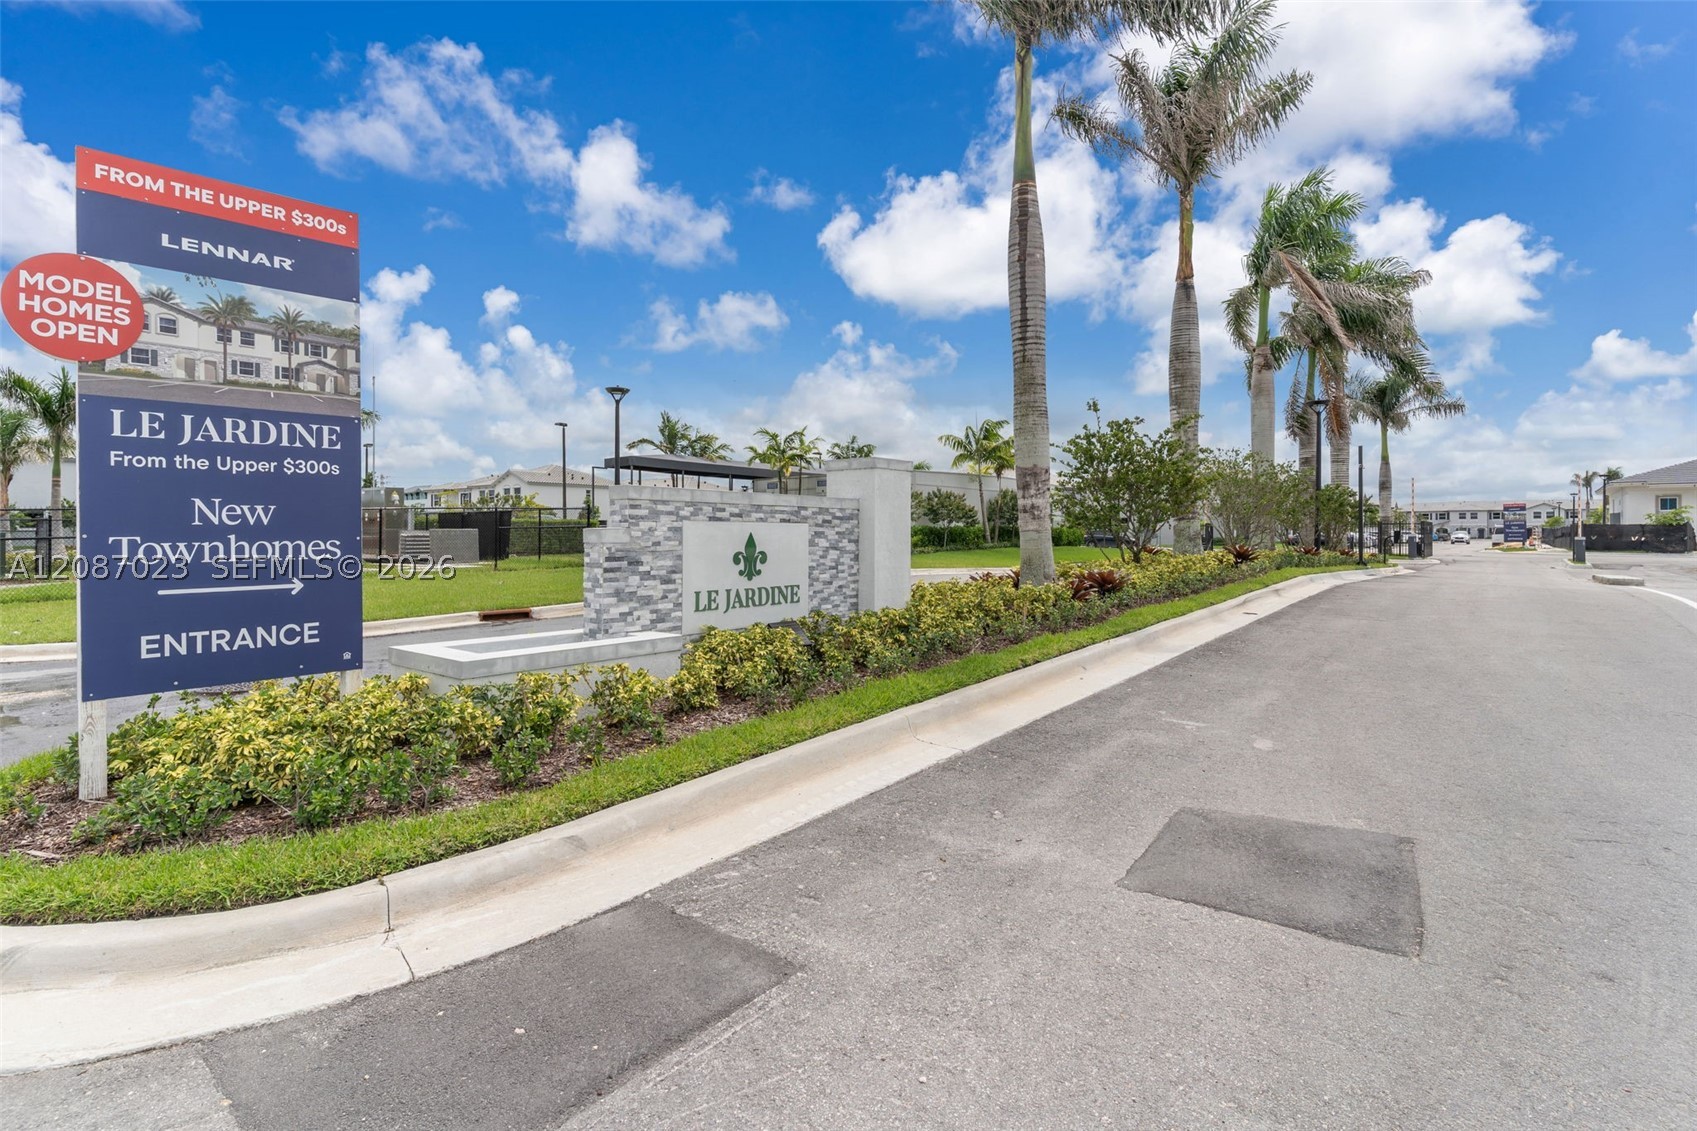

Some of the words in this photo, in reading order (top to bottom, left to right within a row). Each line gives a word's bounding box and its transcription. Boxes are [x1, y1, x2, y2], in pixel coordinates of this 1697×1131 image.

[94, 163, 165, 193] FROM
[170, 181, 214, 205] THE
[219, 193, 286, 221] UPPER
[291, 209, 348, 236] $300s
[161, 233, 294, 271] LENNAR
[19, 270, 131, 304] MODEL
[19, 293, 131, 326] HOMES
[31, 319, 118, 346] OPEN
[110, 409, 165, 439] LE
[178, 414, 342, 450] JARDINE
[110, 451, 167, 469] From
[174, 454, 209, 470] the
[217, 456, 277, 474] Upper
[283, 459, 340, 475] $300s
[191, 498, 276, 526] New
[108, 534, 341, 565] Townhomes
[694, 590, 719, 613] LE
[723, 584, 800, 614] JARDINE
[140, 622, 320, 659] ENTRANCE
